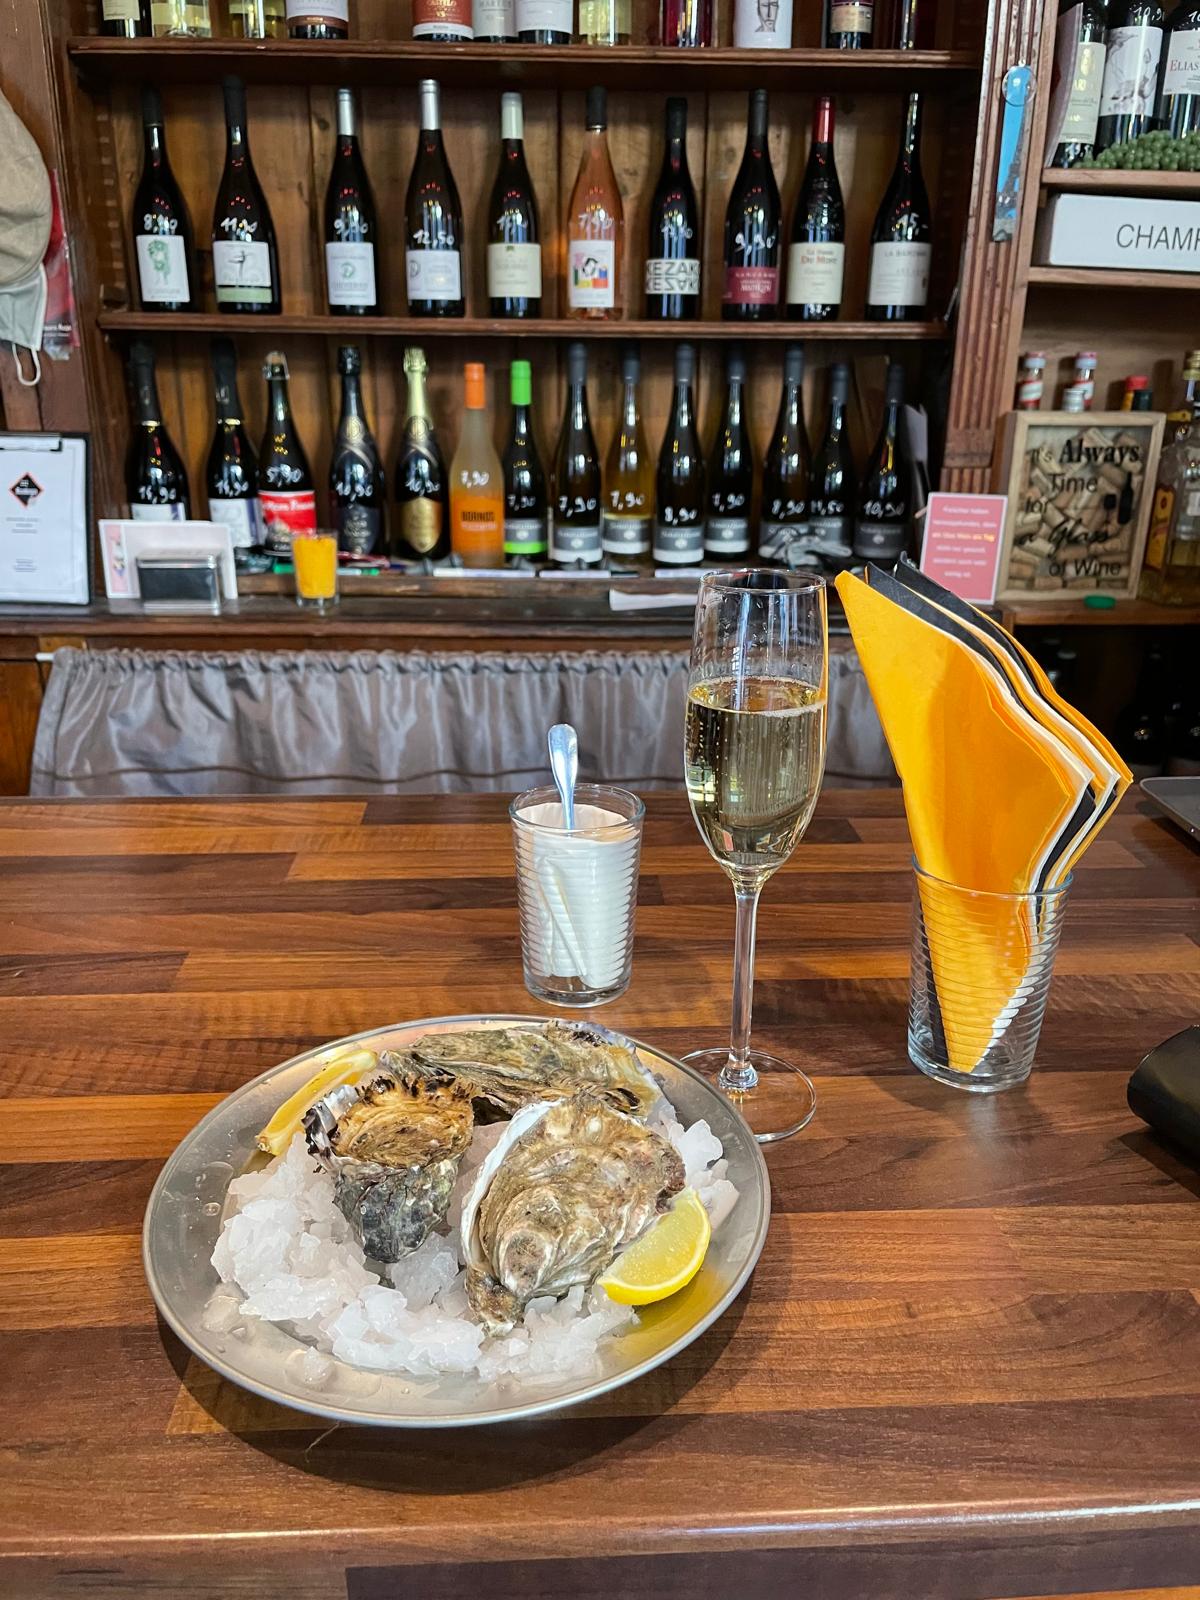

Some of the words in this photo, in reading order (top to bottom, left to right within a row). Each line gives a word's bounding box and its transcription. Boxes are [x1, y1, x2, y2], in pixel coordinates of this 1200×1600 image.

[413, 229, 455, 248] 12,50
[1060, 439, 1139, 466] Always
[1048, 473, 1098, 493] Time
[559, 495, 597, 518] 7,90
[610, 490, 645, 511] 7,90
[1025, 497, 1049, 514] for
[665, 506, 698, 526] 8,90
[1048, 518, 1108, 557] Glass
[1049, 559, 1068, 577] of
[1074, 559, 1121, 576] Wine
